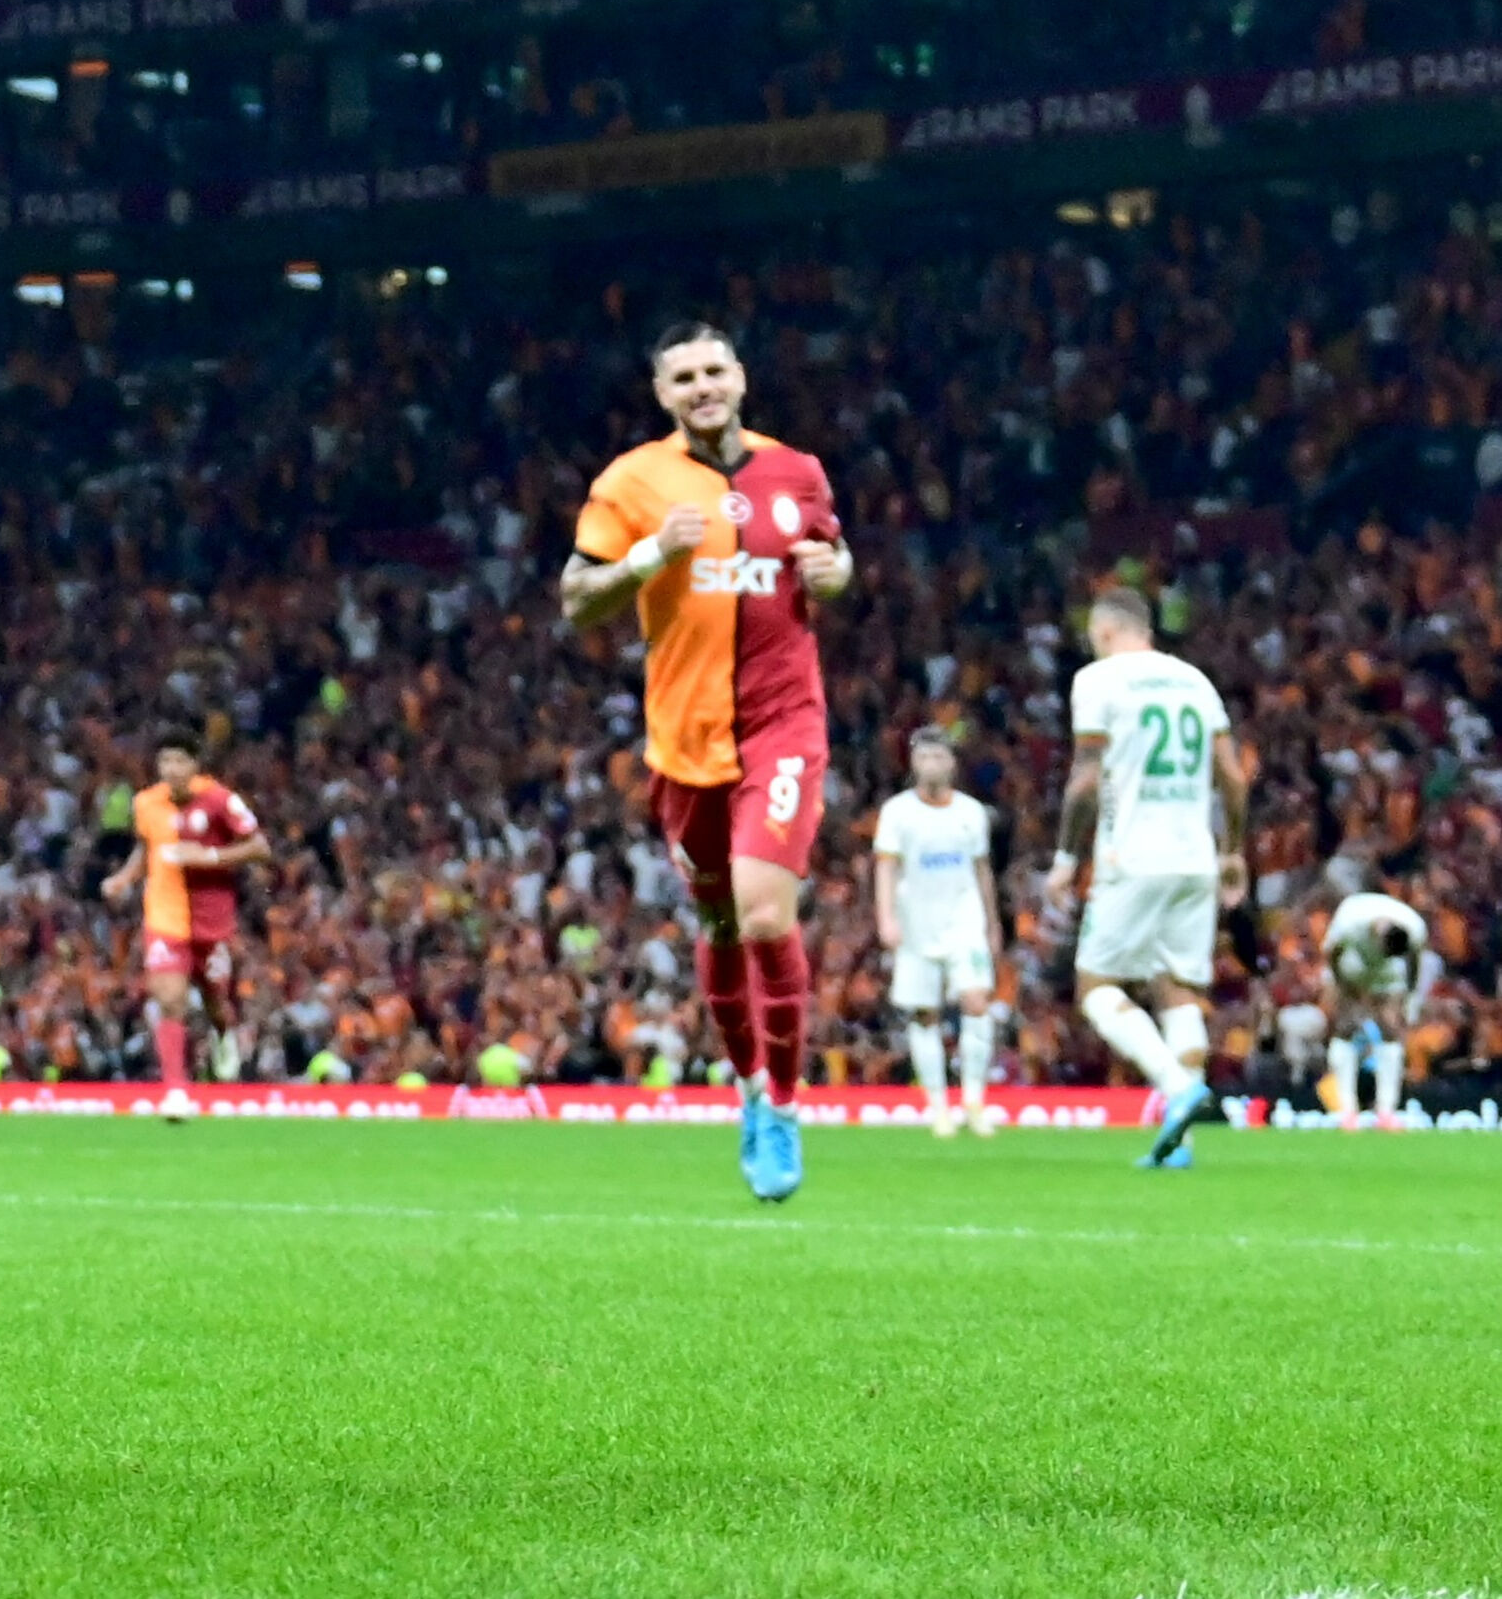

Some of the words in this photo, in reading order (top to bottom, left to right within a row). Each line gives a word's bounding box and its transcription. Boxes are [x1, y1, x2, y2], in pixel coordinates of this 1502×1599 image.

[1291, 58, 1401, 103] RAMS
[930, 97, 1033, 141] RAMS
[1041, 89, 1138, 131] PARK
[19, 192, 122, 227] PARK
[270, 172, 368, 210] RAMS
[376, 165, 464, 200] PARK
[690, 551, 784, 595] SIXT
[1138, 703, 1204, 777] 29
[768, 776, 800, 823] 9
